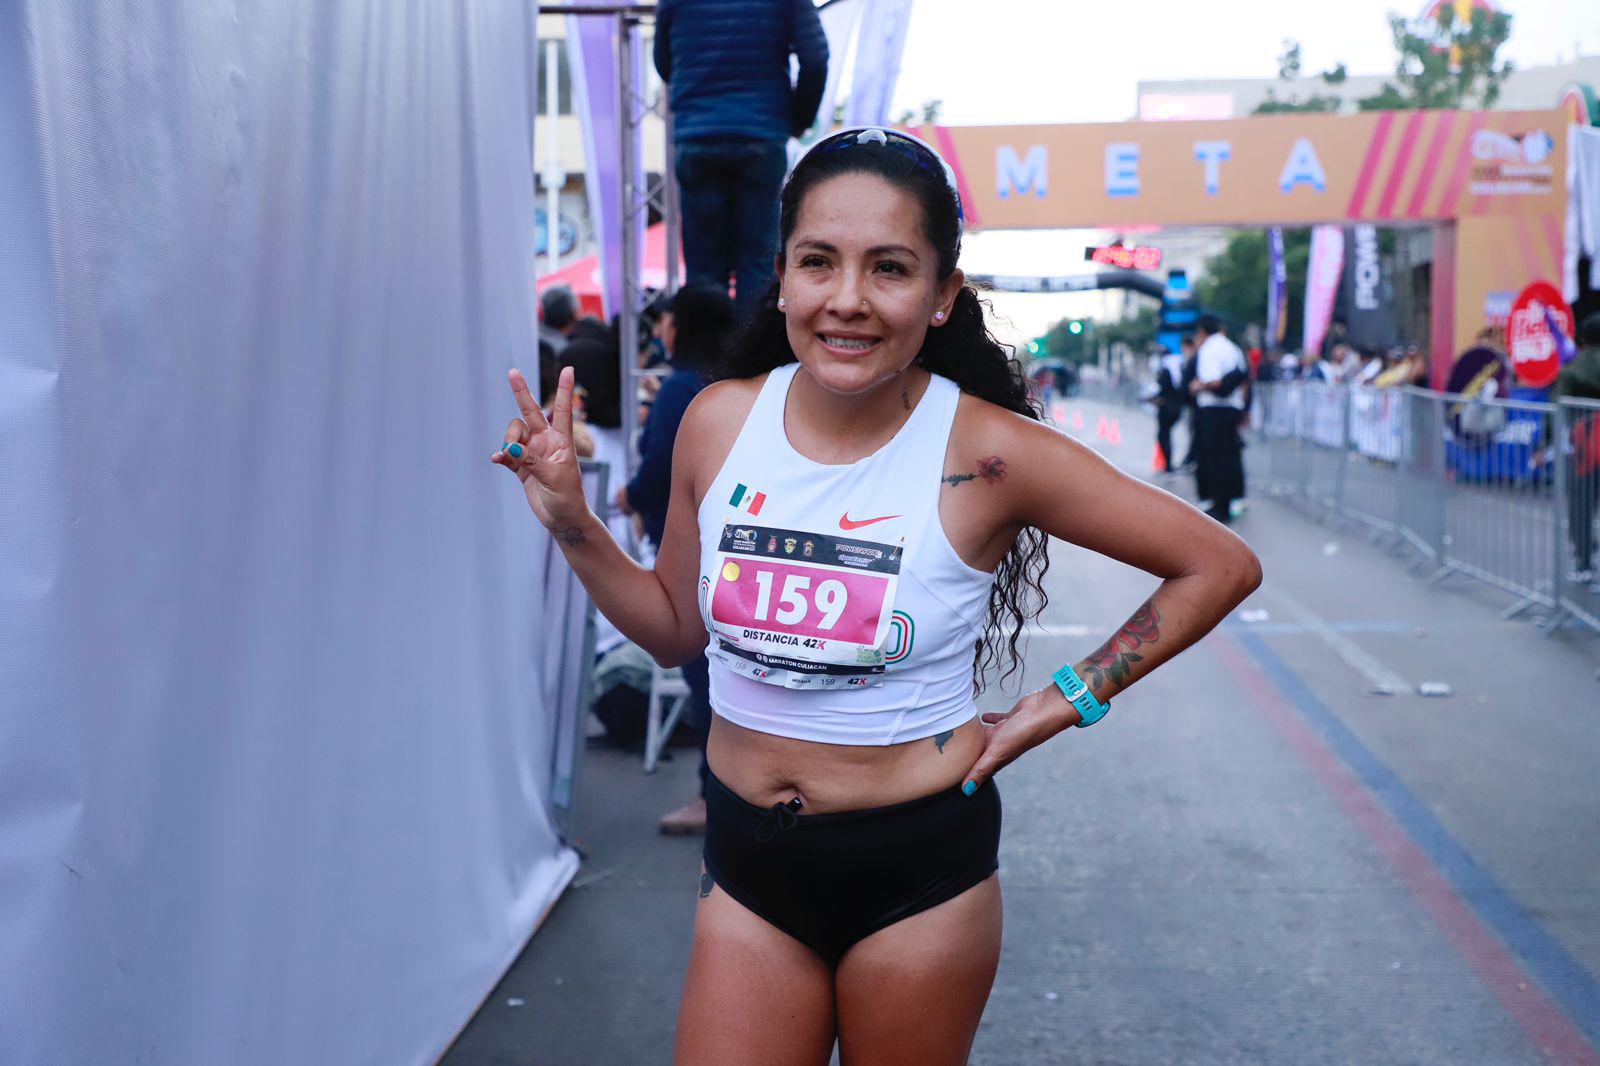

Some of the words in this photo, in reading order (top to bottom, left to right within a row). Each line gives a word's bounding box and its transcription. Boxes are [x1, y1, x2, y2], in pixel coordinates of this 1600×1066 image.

[995, 138, 1327, 198] META
[755, 571, 848, 630] 159
[743, 629, 799, 646] DISTANCIA
[802, 637, 826, 650] 42K
[734, 661, 748, 671] 159
[821, 678, 836, 686] 159
[847, 678, 867, 686] 42K
